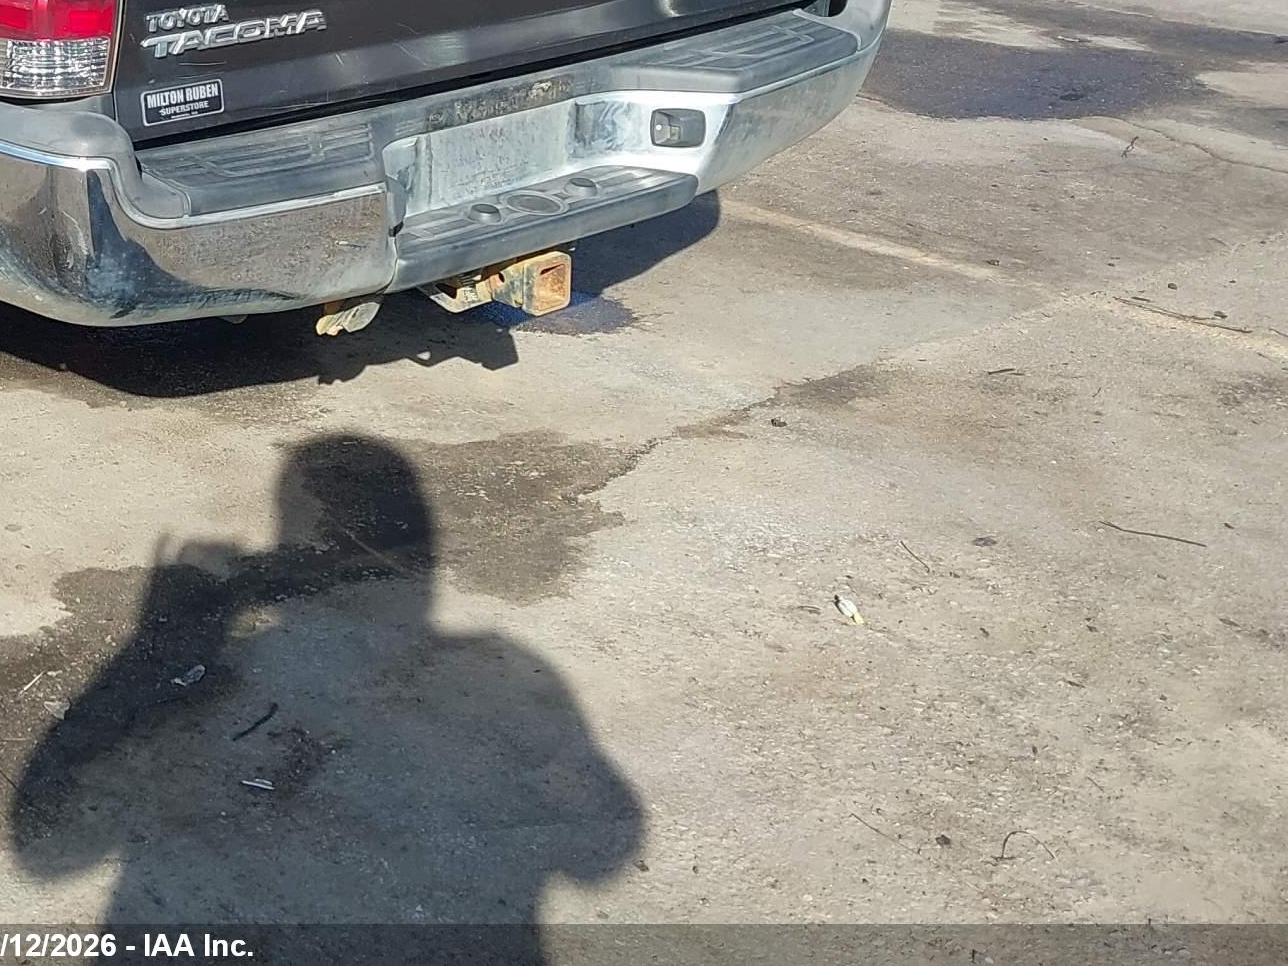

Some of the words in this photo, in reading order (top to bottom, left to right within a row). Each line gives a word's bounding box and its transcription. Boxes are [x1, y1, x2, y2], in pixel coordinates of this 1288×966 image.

[145, 3, 230, 33] TOYOTA
[140, 9, 327, 58] TACOMA
[146, 89, 185, 109] MILTON
[184, 82, 219, 102] RUBEN
[159, 100, 209, 115] SUPERSTORE
